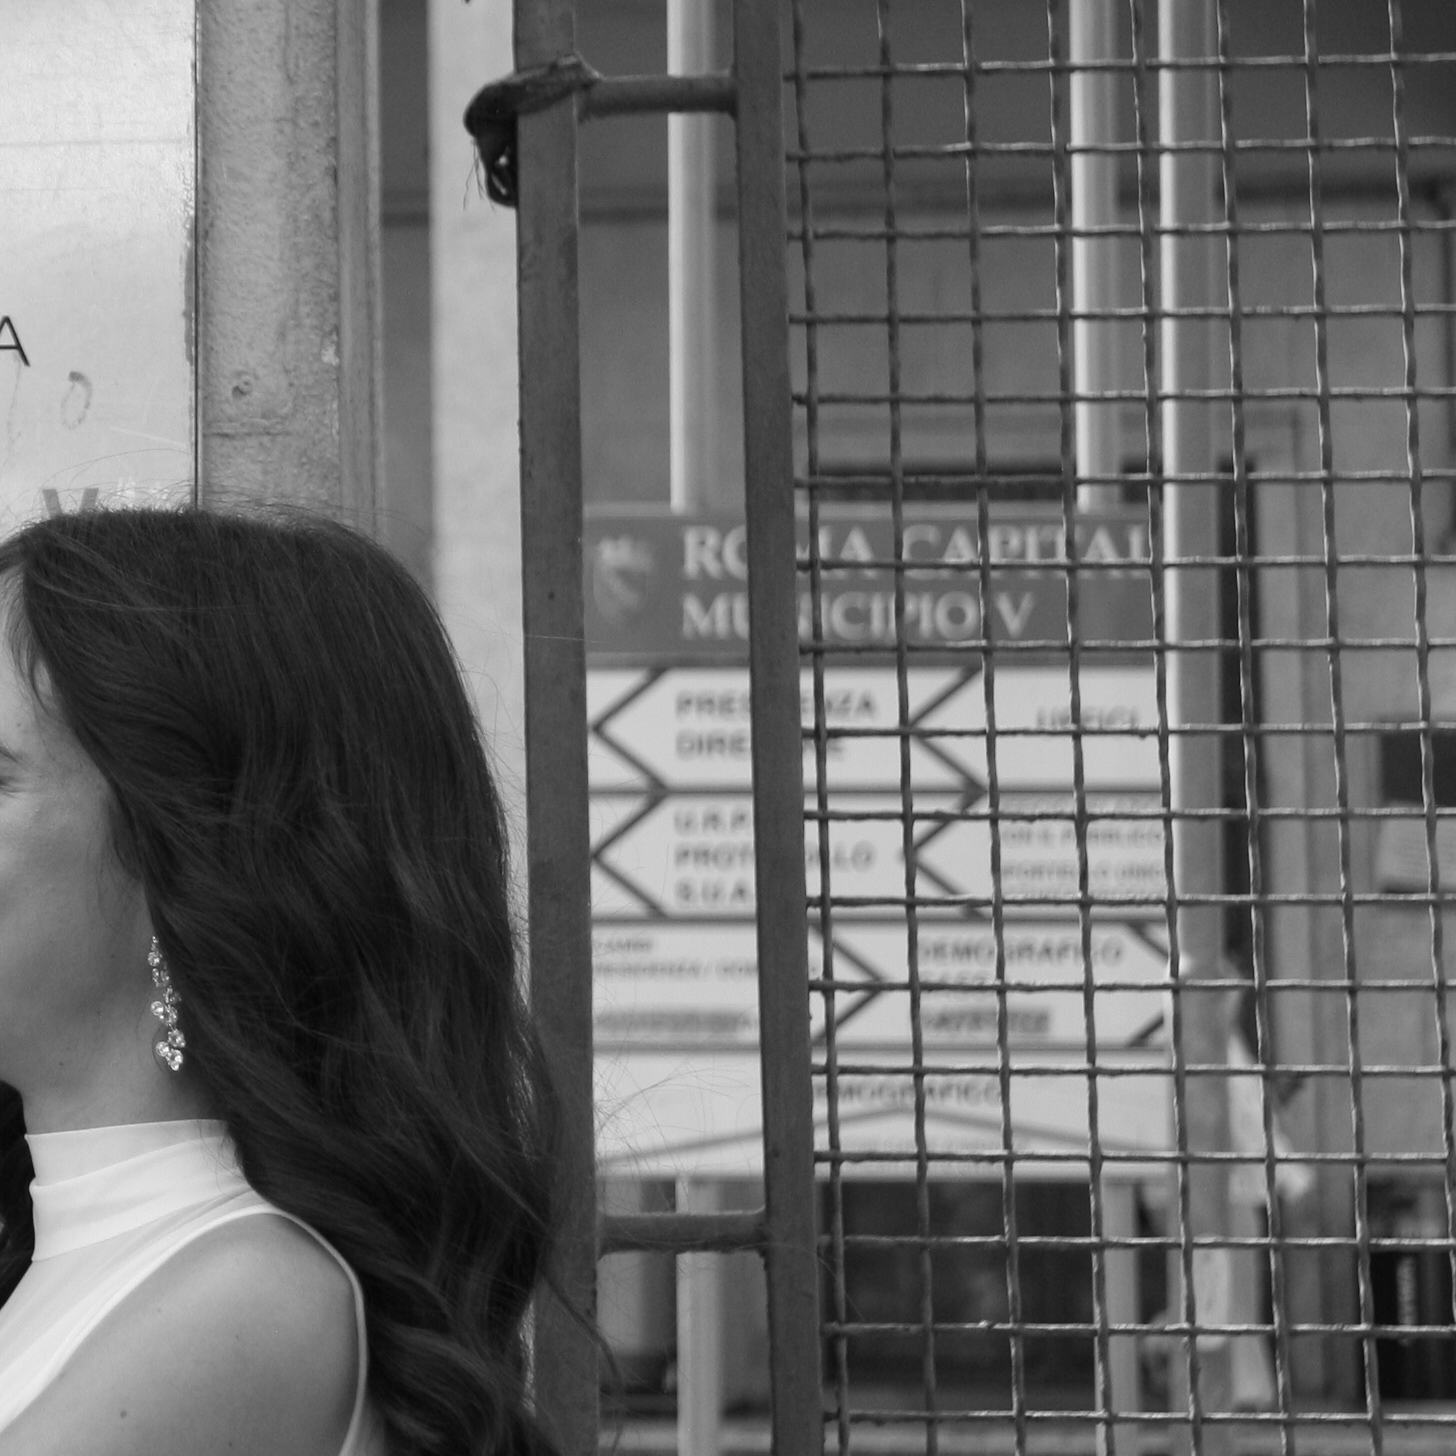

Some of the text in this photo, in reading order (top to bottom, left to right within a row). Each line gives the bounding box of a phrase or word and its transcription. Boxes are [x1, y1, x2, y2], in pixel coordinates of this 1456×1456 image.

[899, 524, 1150, 580] CAPITAL
[680, 591, 1035, 640] MICIPIO V
